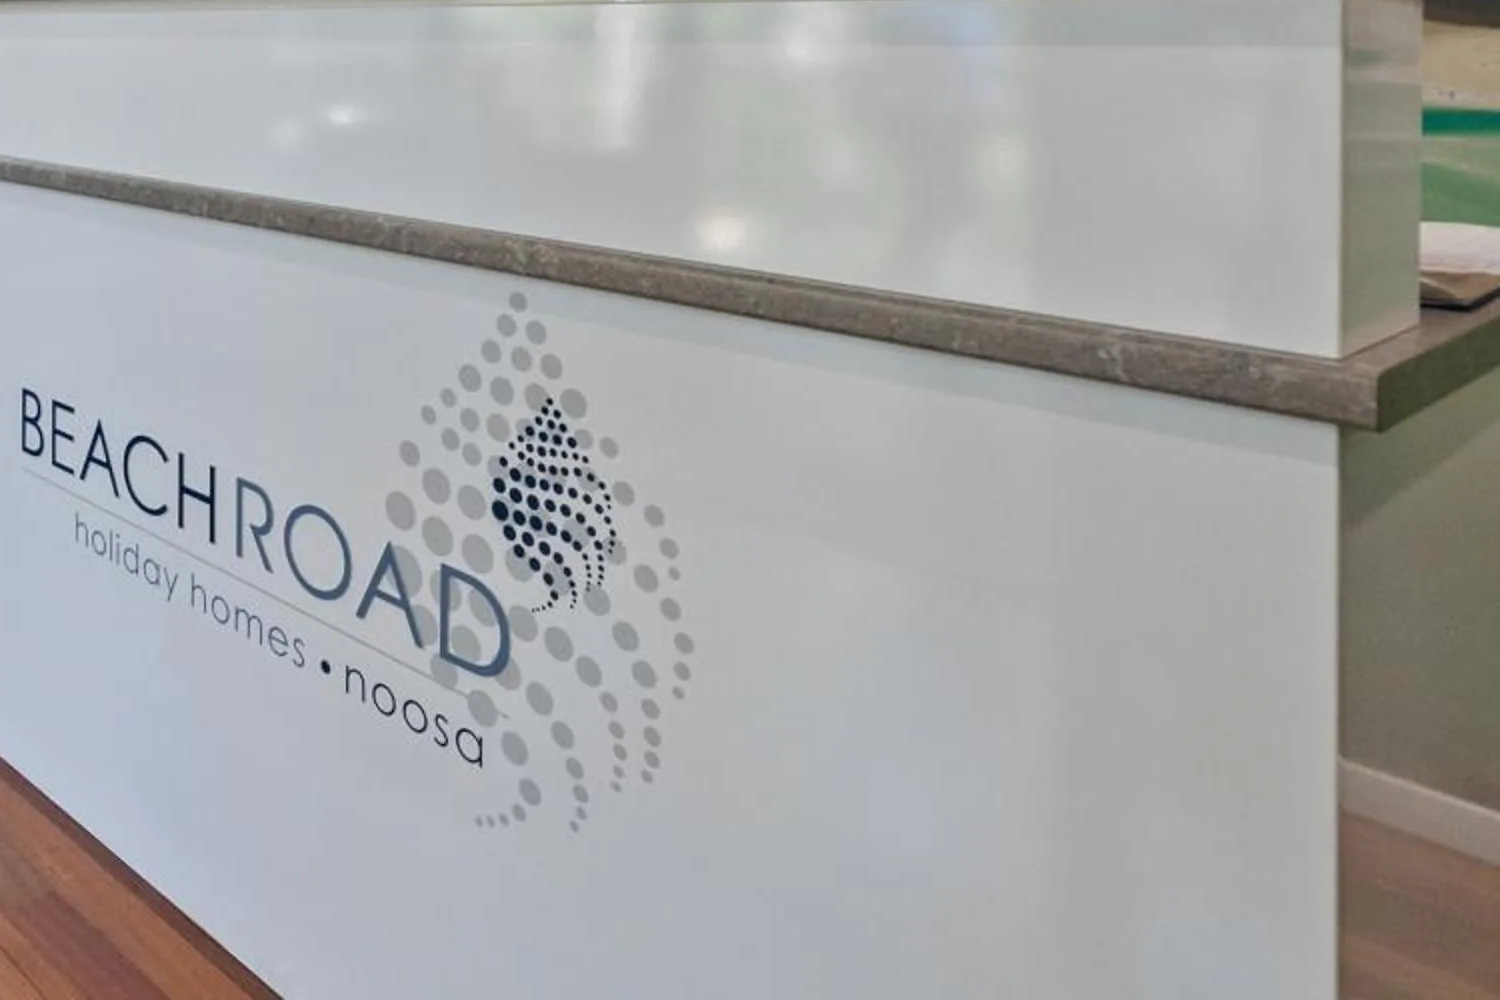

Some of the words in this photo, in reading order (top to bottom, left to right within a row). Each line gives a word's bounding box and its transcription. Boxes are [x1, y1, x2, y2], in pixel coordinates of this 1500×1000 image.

[74, 511, 179, 603] holiday
[190, 572, 307, 668] homes
[344, 664, 485, 768] noosa
